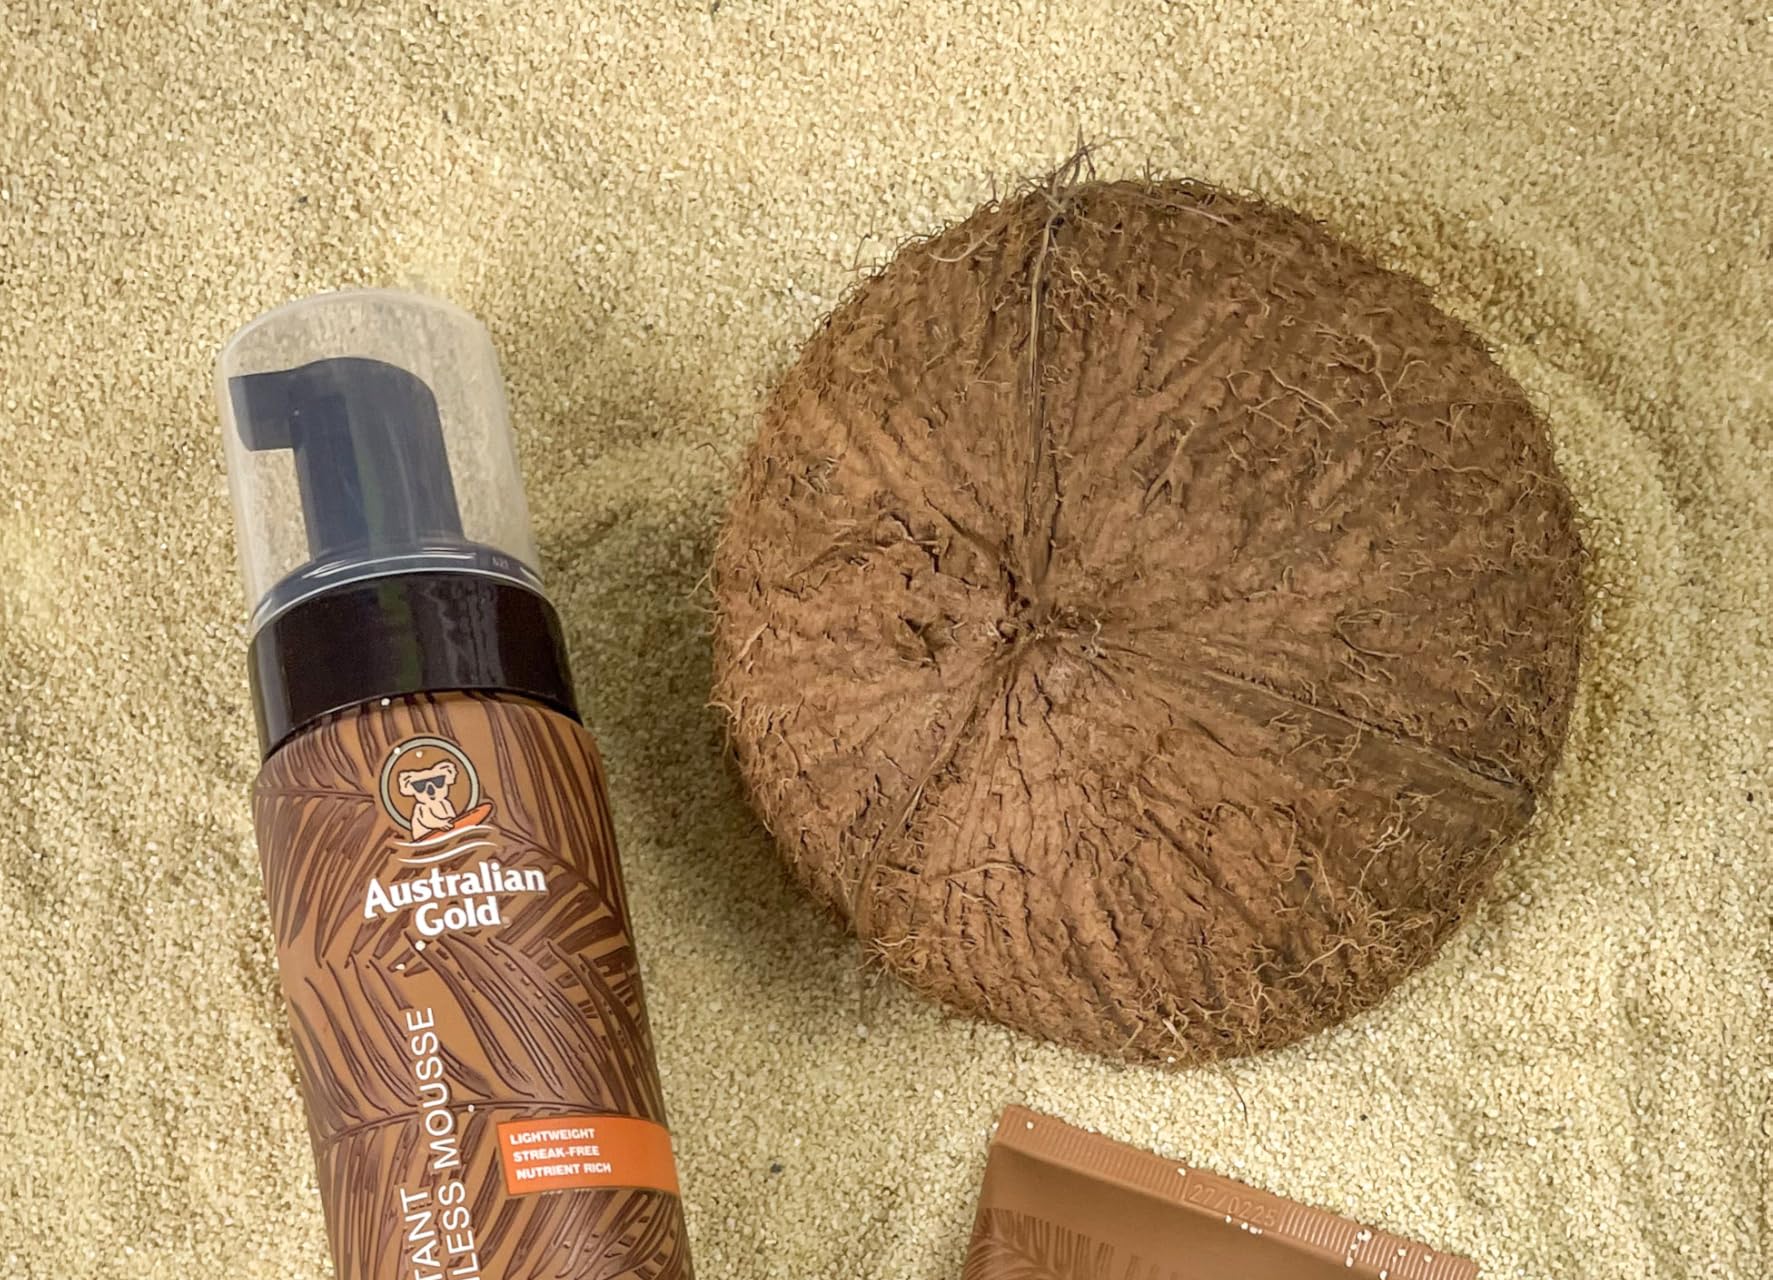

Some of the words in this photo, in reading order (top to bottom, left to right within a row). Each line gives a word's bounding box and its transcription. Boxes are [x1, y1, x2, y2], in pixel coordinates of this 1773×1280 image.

[364, 861, 548, 919] Australian
[415, 896, 501, 937] Gold
[406, 1007, 459, 1170] MOUSSE
[509, 1128, 595, 1145] LIGHTWEIGHT
[513, 1145, 600, 1163] STREAK-FREE
[516, 1163, 581, 1180] NUTRIENT
[583, 1162, 612, 1174] RICH
